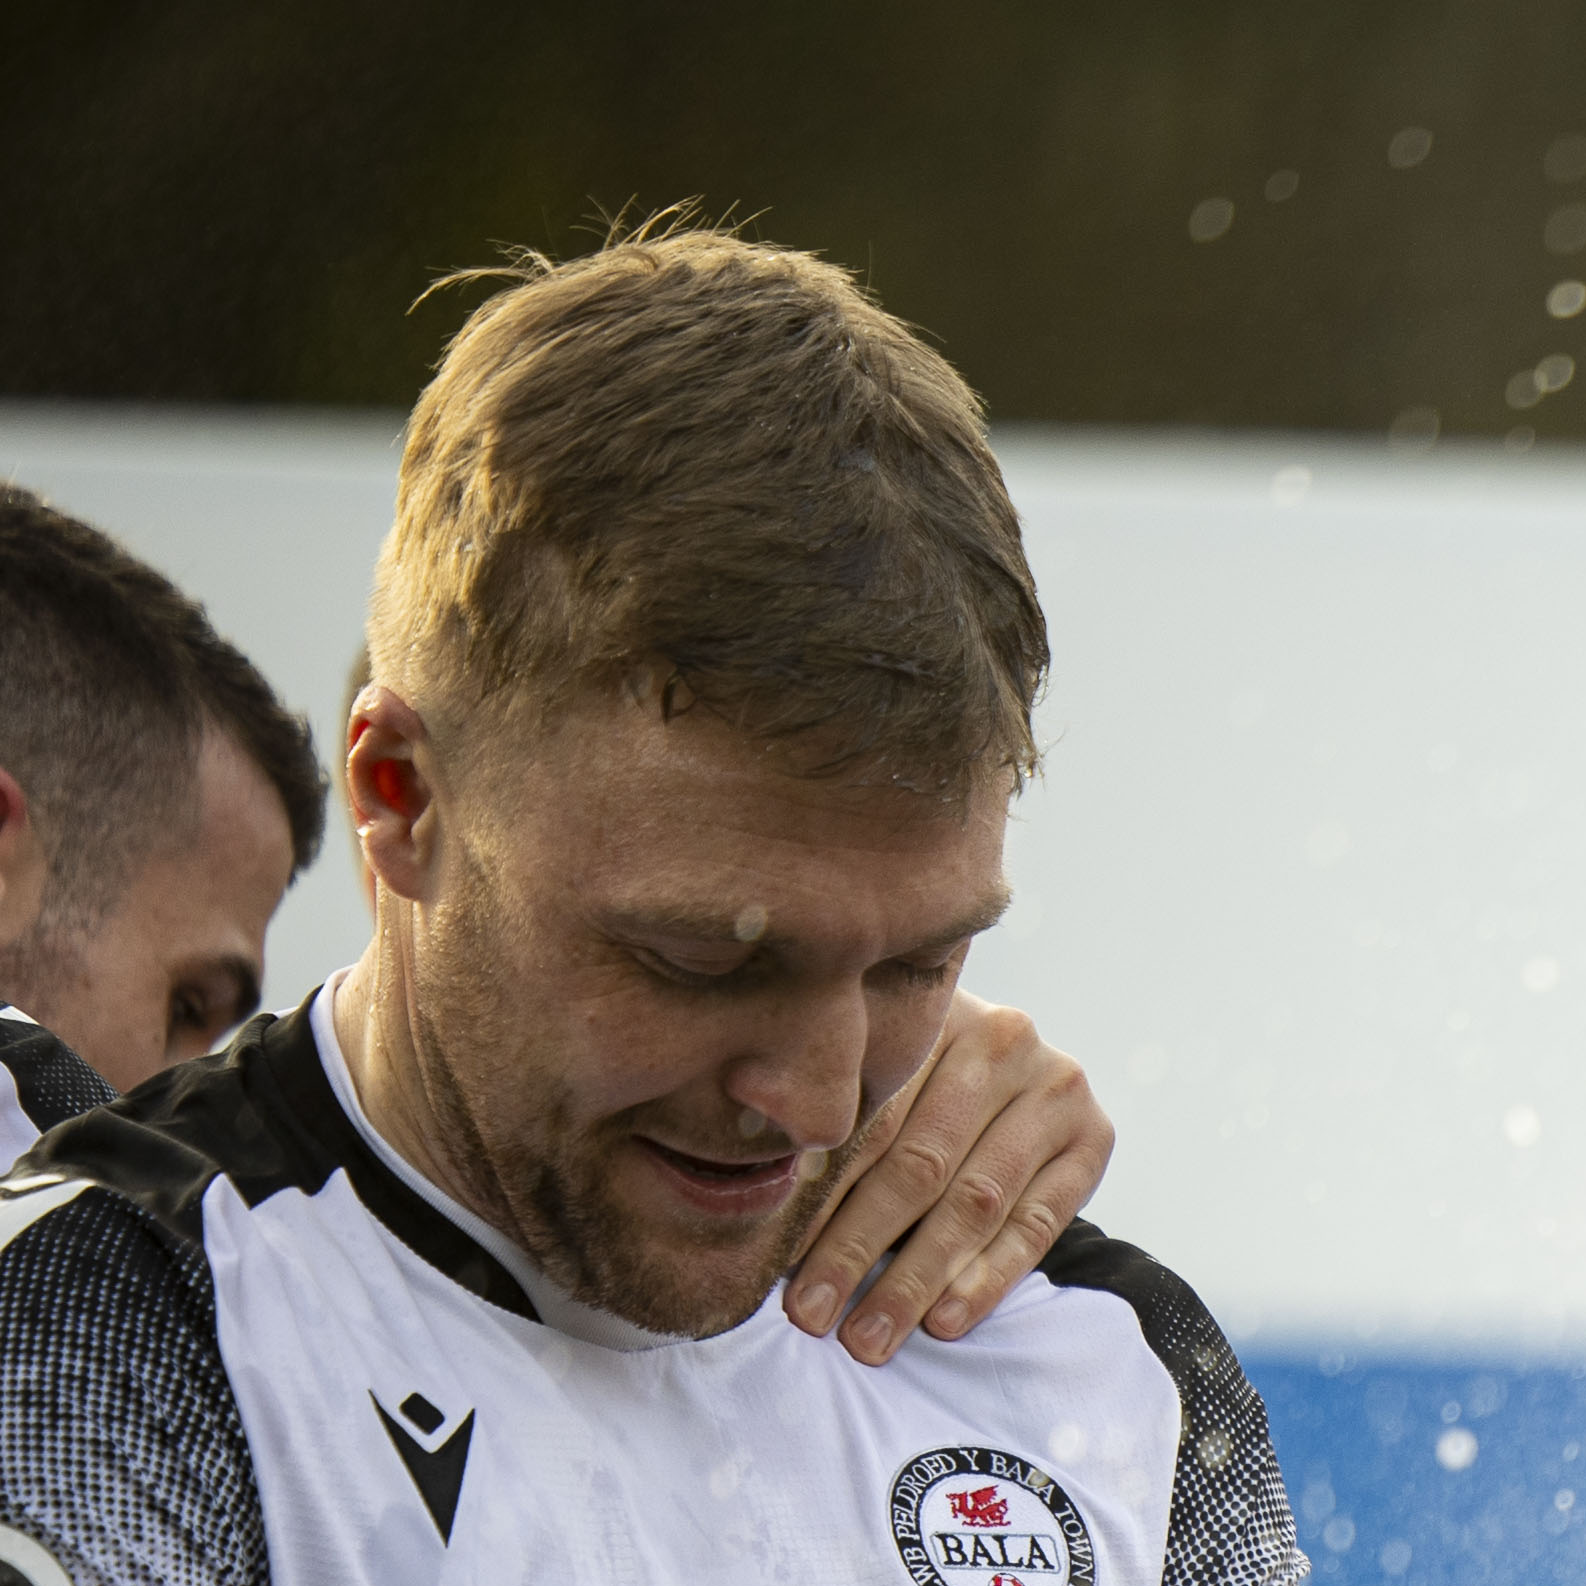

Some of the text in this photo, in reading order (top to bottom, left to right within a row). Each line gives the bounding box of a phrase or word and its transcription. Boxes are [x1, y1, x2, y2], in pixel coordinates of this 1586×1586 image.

[934, 1533, 1056, 1571] BALA
[958, 1449, 979, 1472] Y
[990, 1452, 1056, 1504] BALA
[1055, 1502, 1093, 1583] TOWN
